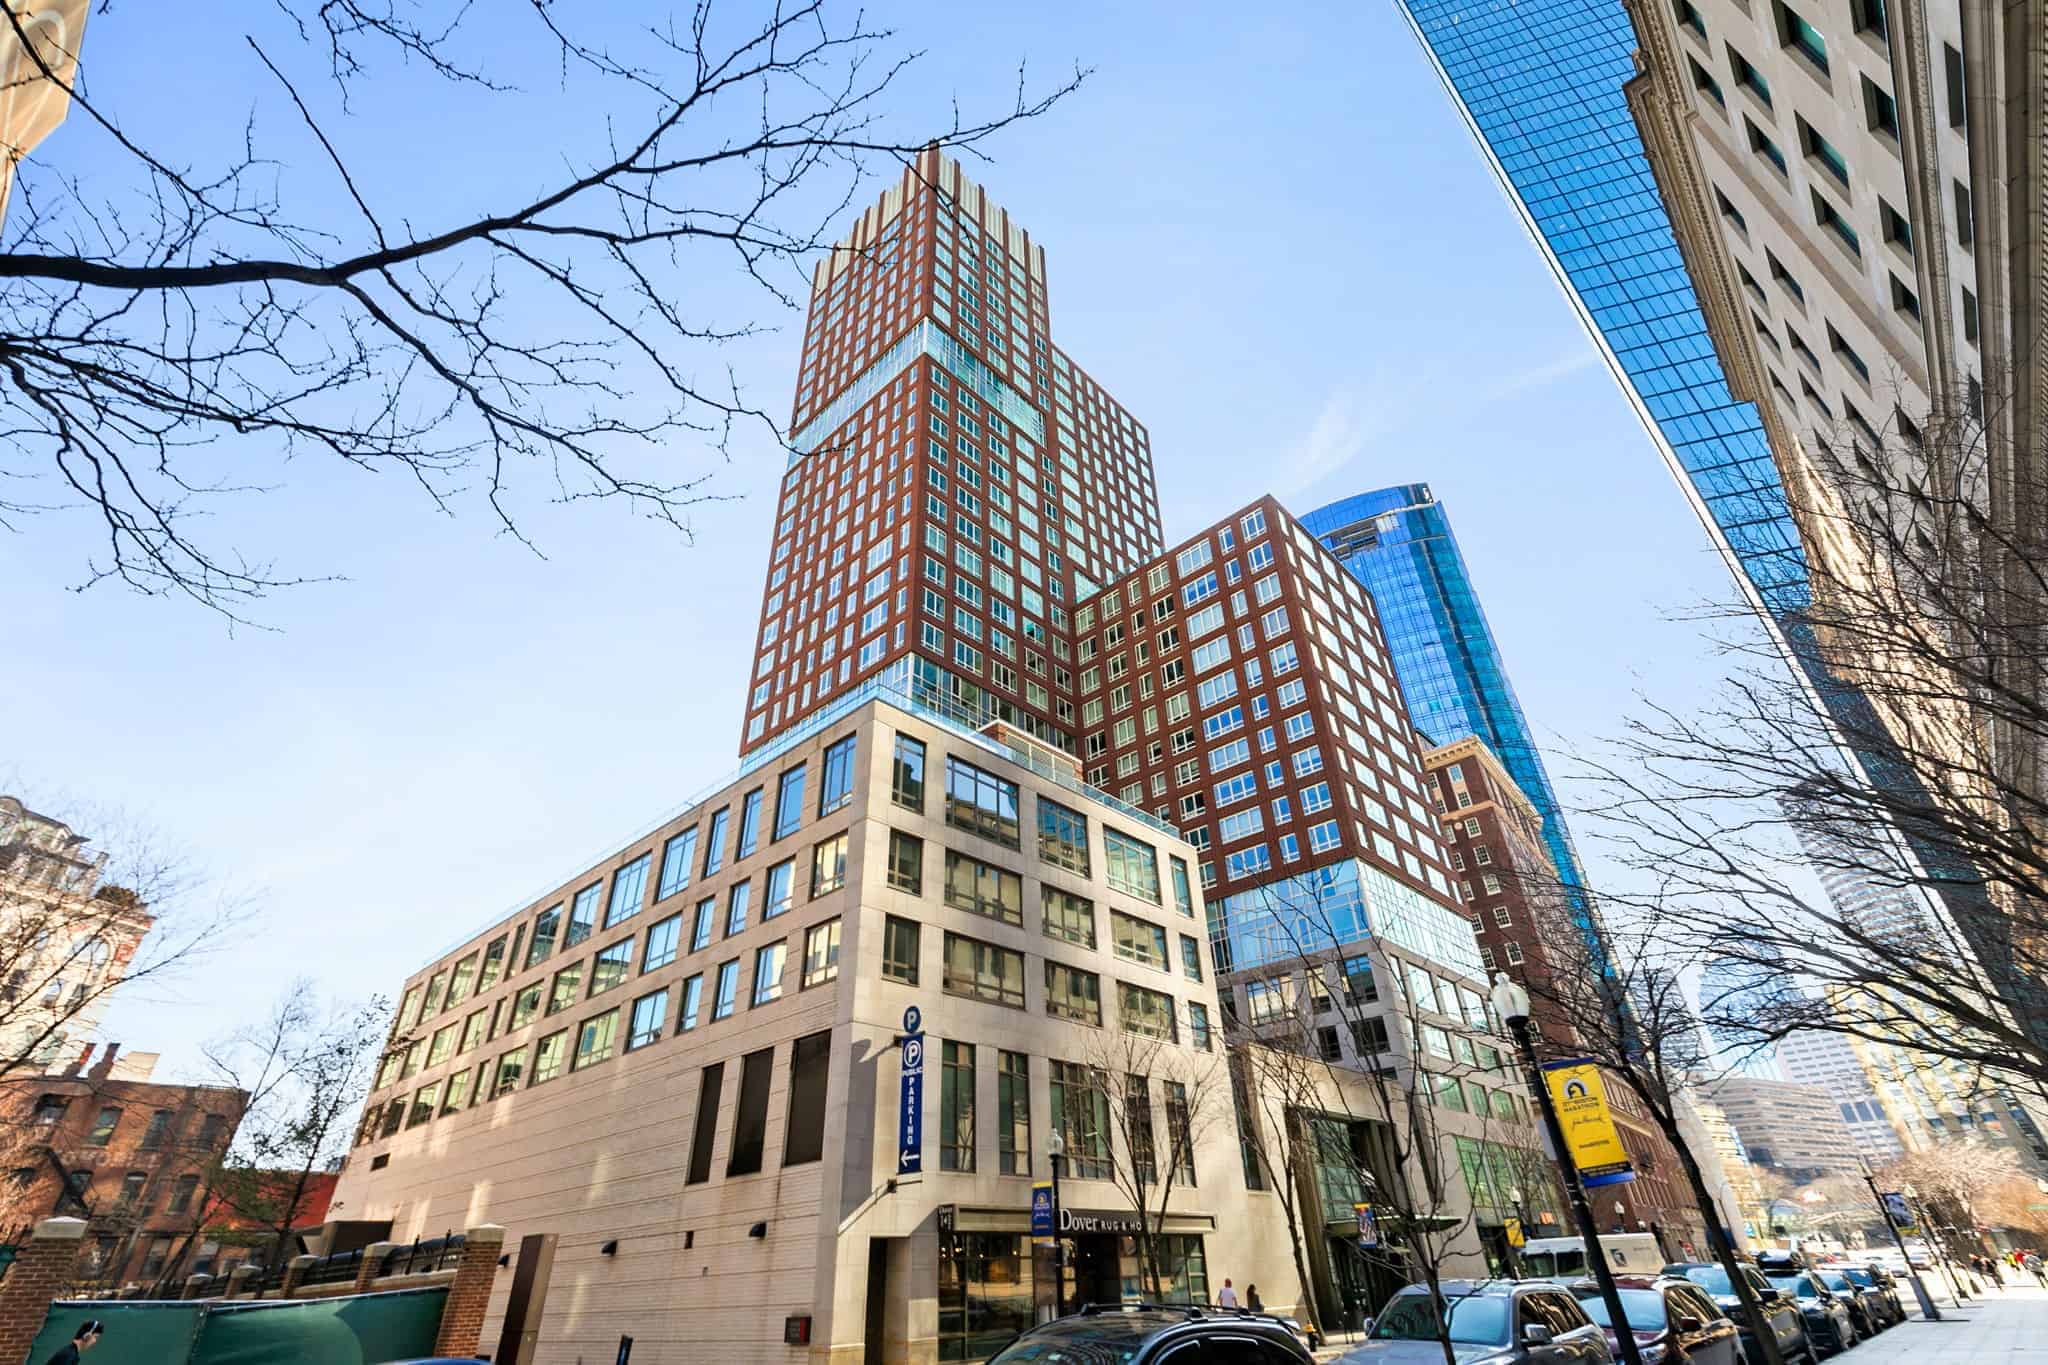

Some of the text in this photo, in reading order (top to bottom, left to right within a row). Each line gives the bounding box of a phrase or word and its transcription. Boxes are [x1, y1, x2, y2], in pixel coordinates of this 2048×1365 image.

[907, 1011, 917, 1030] P
[908, 1044, 918, 1063] P
[906, 1076, 915, 1145] PARKING
[1059, 1208, 1098, 1232] Dover
[1101, 1219, 1119, 1232] RUG
